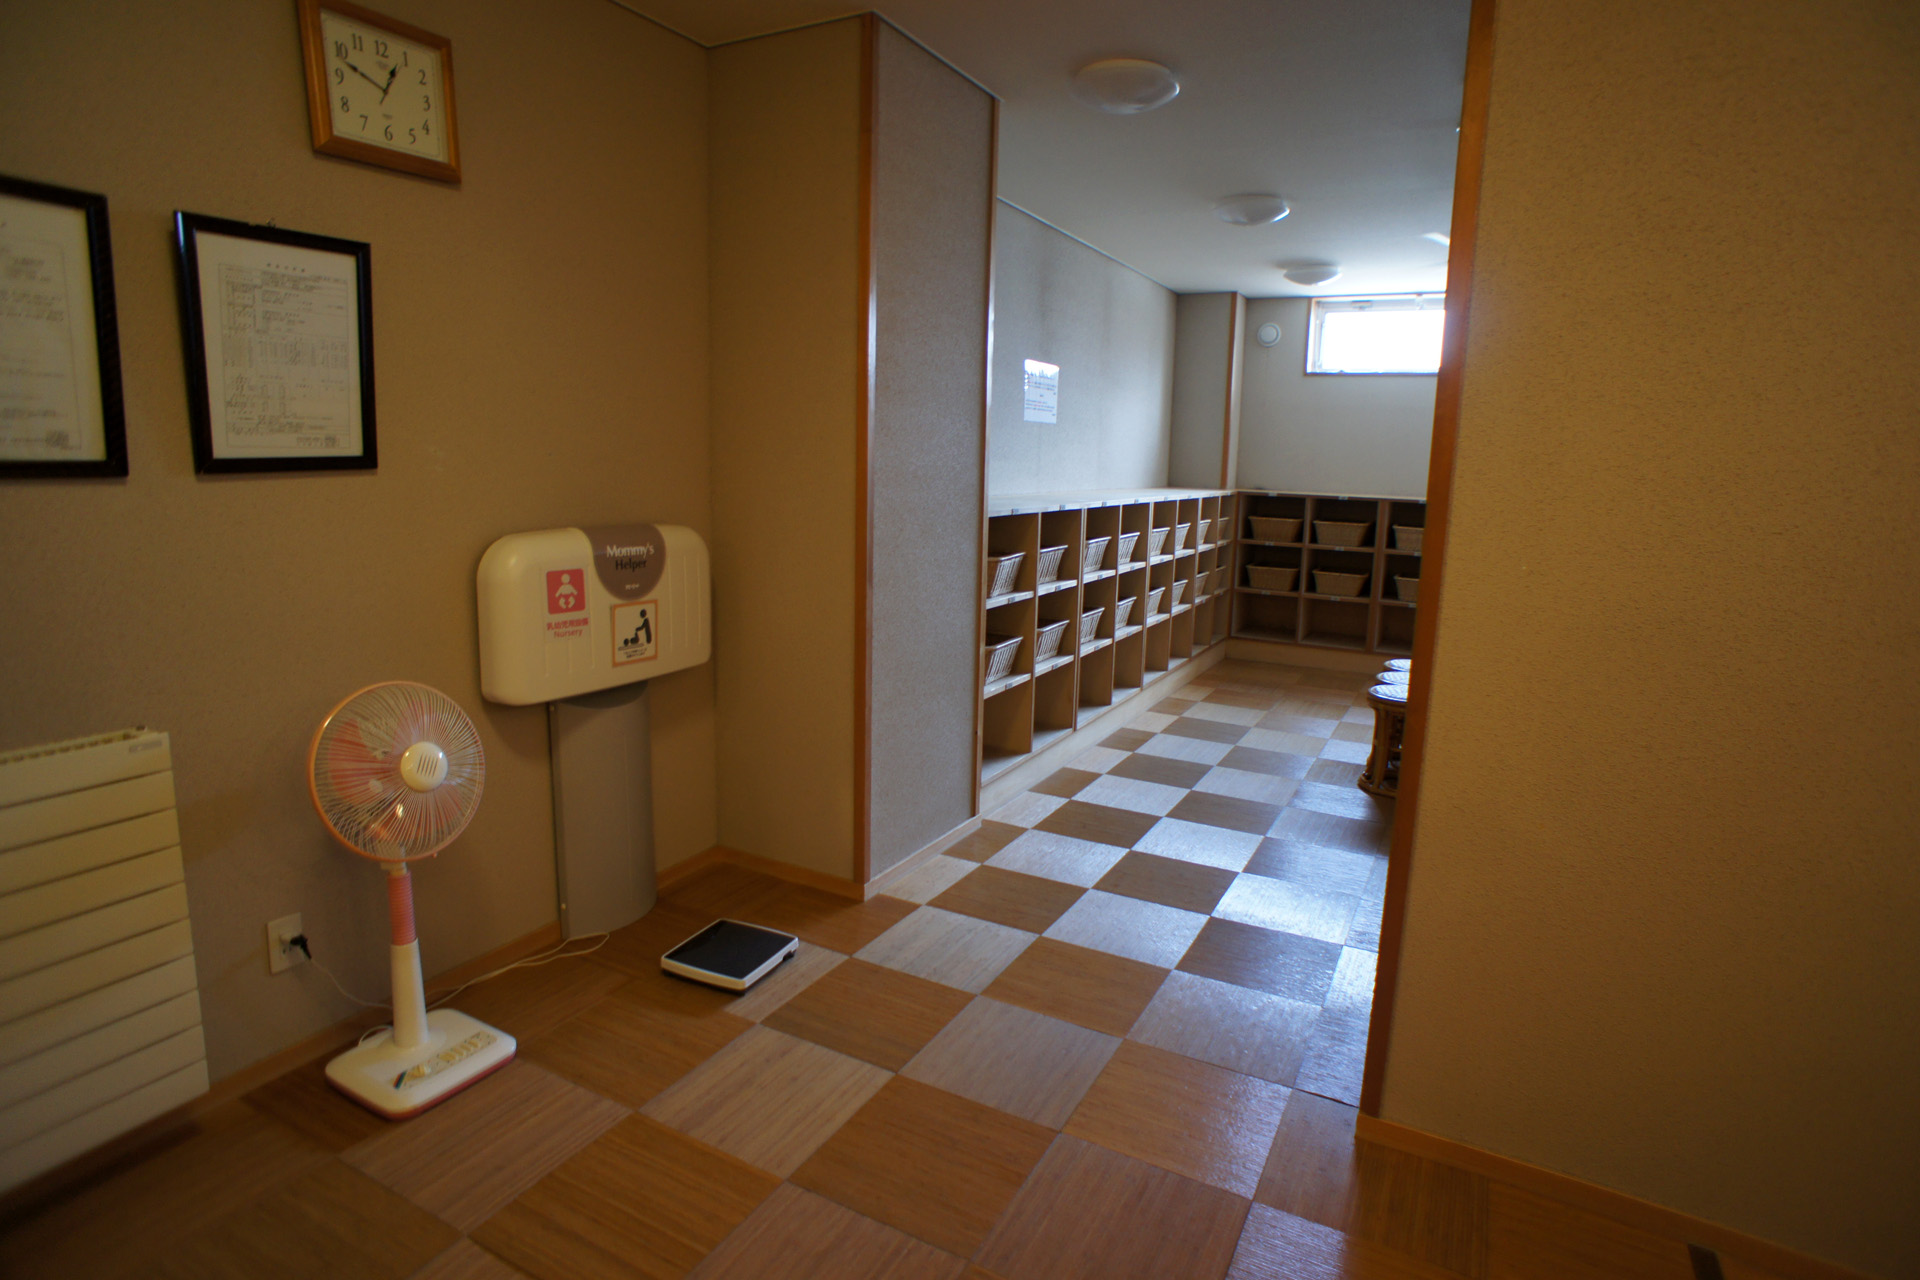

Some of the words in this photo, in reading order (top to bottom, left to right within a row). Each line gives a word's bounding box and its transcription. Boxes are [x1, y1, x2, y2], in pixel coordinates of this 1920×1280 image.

[335, 41, 348, 60] 10
[352, 33, 363, 51] 11
[374, 40, 389, 59] 12
[403, 51, 408, 67] 1
[335, 67, 344, 85] 9
[418, 69, 426, 85] 2
[341, 96, 350, 113] 8
[423, 95, 431, 112] 3
[360, 115, 368, 131] 7
[422, 119, 430, 136] 4
[385, 125, 393, 141] 6
[409, 128, 416, 144] 5
[606, 542, 655, 559] Mommy's
[615, 557, 647, 572] Helper
[554, 628, 583, 638] Nursery
